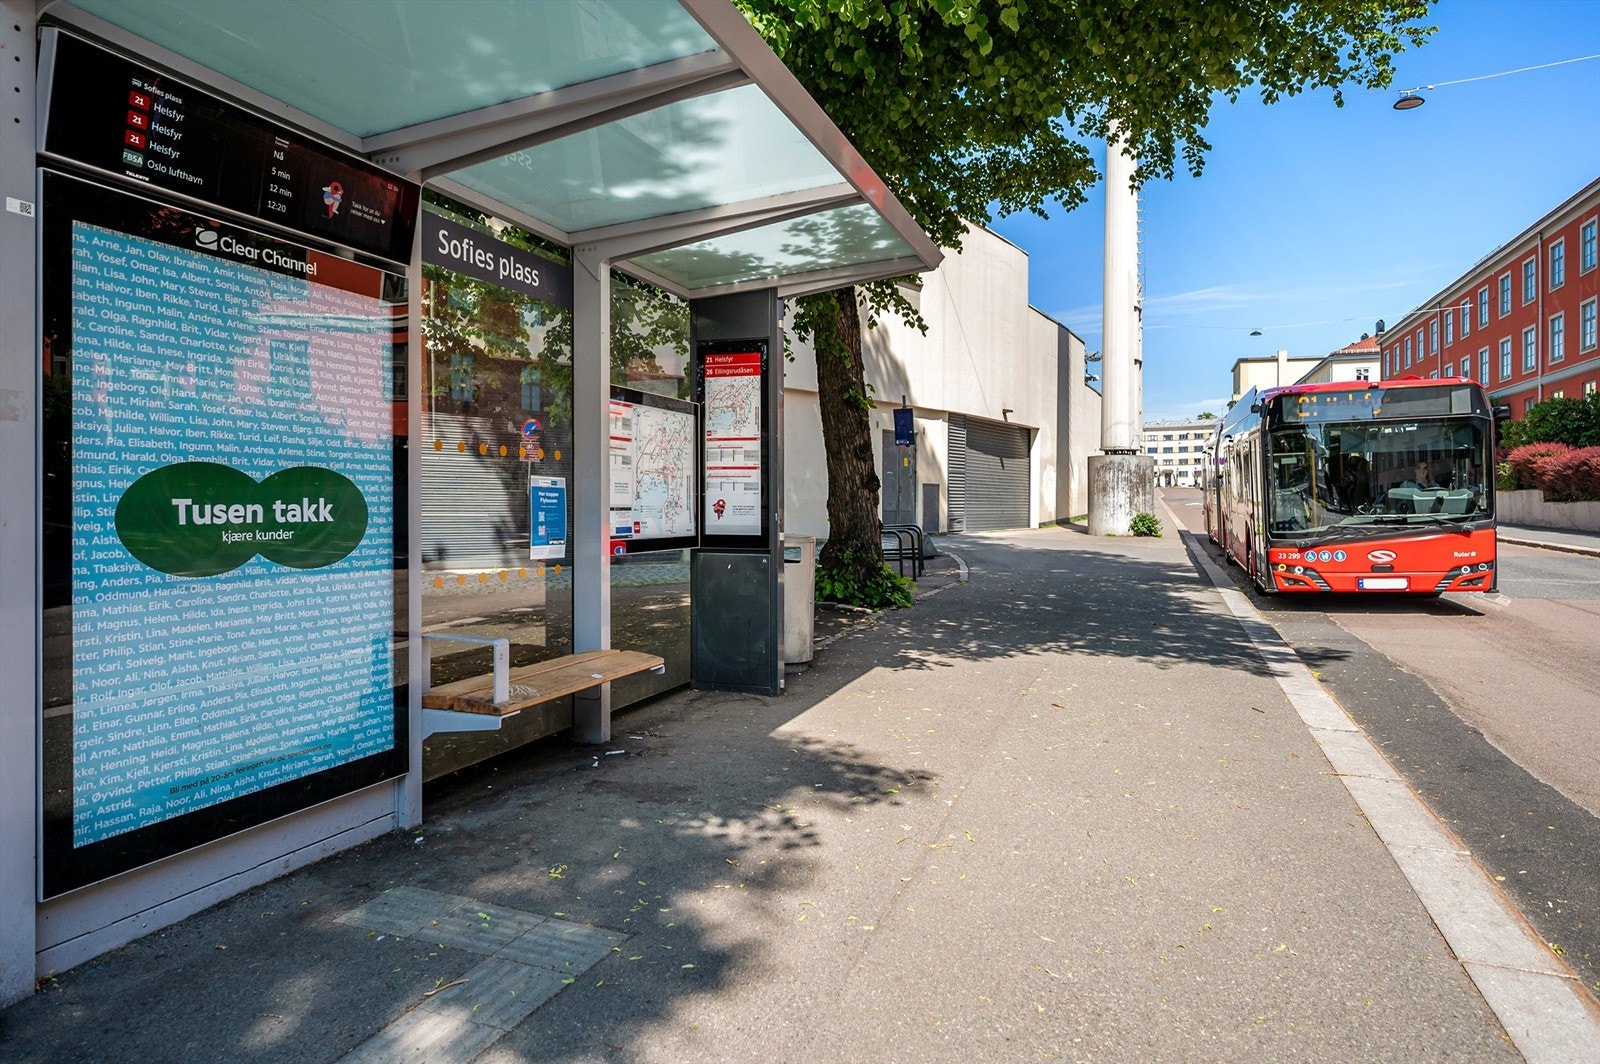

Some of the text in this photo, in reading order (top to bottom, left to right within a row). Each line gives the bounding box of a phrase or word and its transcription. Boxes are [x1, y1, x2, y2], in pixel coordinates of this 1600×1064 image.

[144, 83, 182, 104] Sofies plass
[134, 96, 185, 122] 21 Helsfyr
[132, 115, 183, 141] 21 Helsfyr
[130, 134, 180, 159] 21 Helsfyr
[273, 150, 284, 161] Nå
[123, 151, 203, 185] FB5A Oslo lufthavn
[271, 166, 291, 180] 5 min
[269, 183, 292, 198] 12 min
[267, 200, 287, 213] 12:20
[91, 236, 211, 274] Arne, Jan, Olav, Ibrahim,
[96, 250, 179, 279] Yosef, Omar, Isa,
[220, 237, 318, 276] Clear Channel
[437, 228, 540, 287] Sofies plass
[103, 267, 187, 294] Lisa, John, Mary,
[95, 279, 221, 313] Halvor, Iben, Rikke, Turid,
[100, 309, 202, 336] Olga, Ragnhild, Brit,
[114, 297, 257, 333] Ingunn, Malin, Andrea, Arlene,
[88, 321, 227, 352] Caroline, Sandra, Charlotte,
[103, 337, 224, 364] Hilde, Ida, Inese, Ingrida,
[98, 407, 210, 426] Mathilde, William, Lisa,
[128, 438, 215, 452] Elisabeth, Ingunn,
[149, 425, 237, 441] Halvor, Iben, Rikke,
[108, 464, 136, 476] Eirik,
[171, 497, 335, 526] Tusen takk
[221, 528, 296, 544] kjære kunder
[90, 547, 126, 560] Jacob,
[1278, 552, 1301, 560] 23 299
[93, 561, 144, 574] Thaksiya,
[100, 574, 164, 588] Anders, Pia,
[102, 596, 215, 616] Mathias, Eirik, Caroline,
[96, 609, 209, 631] Magnus, Helena, Hilde,
[102, 633, 225, 658] Philip, Stian, Stine-Marie,
[105, 622, 213, 644] Kristin, Lina, Madelen,
[91, 658, 226, 689] Noor, Aisha, Knut,
[98, 650, 197, 673] Kari, Solveig, Marit,
[99, 691, 180, 716] Linnea, Jørgen,
[92, 703, 198, 731] Einar, Gunnar, Erling,
[107, 716, 200, 743] Sindre, Linn, Ellen,
[122, 719, 239, 753] Nathalia, Emma, Mathias,
[100, 744, 180, 772] Henning, Heidi,
[99, 755, 190, 787] Kim, Kjell, Kjersti,
[91, 766, 203, 803] Øyvind, Petter, Philip,
[94, 795, 192, 831] Hassan, Raja, Noor,
[96, 797, 135, 816] Astrid,
